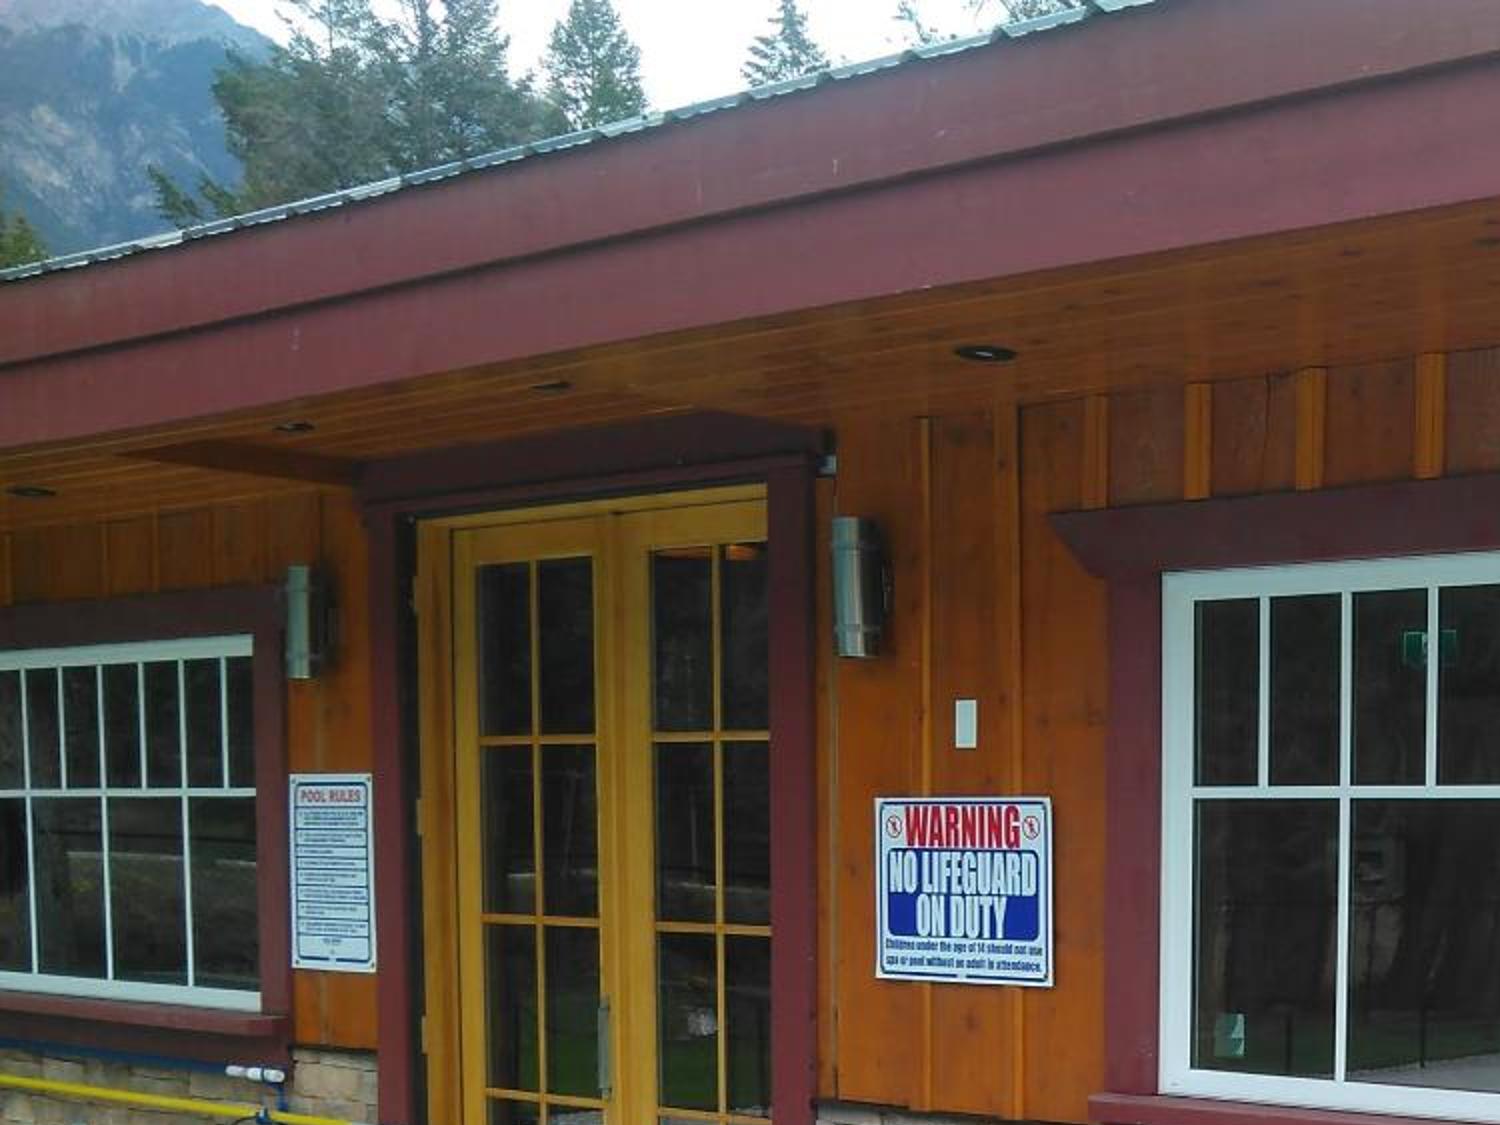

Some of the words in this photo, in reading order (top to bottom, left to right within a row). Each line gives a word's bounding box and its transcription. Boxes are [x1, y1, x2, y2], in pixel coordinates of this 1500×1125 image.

[300, 789, 327, 803] POOL
[329, 789, 361, 803] RULES
[904, 805, 1020, 848] WARNING
[889, 850, 918, 893] NO
[921, 851, 1037, 896] LIFEGUARD
[916, 893, 945, 937] ON
[950, 895, 1008, 938] DUTY
[886, 938, 915, 950] Children
[916, 940, 939, 951] under
[940, 941, 951, 952] the
[953, 943, 967, 954] age
[968, 942, 977, 953] of
[987, 943, 1013, 955] should
[926, 956, 955, 967] without
